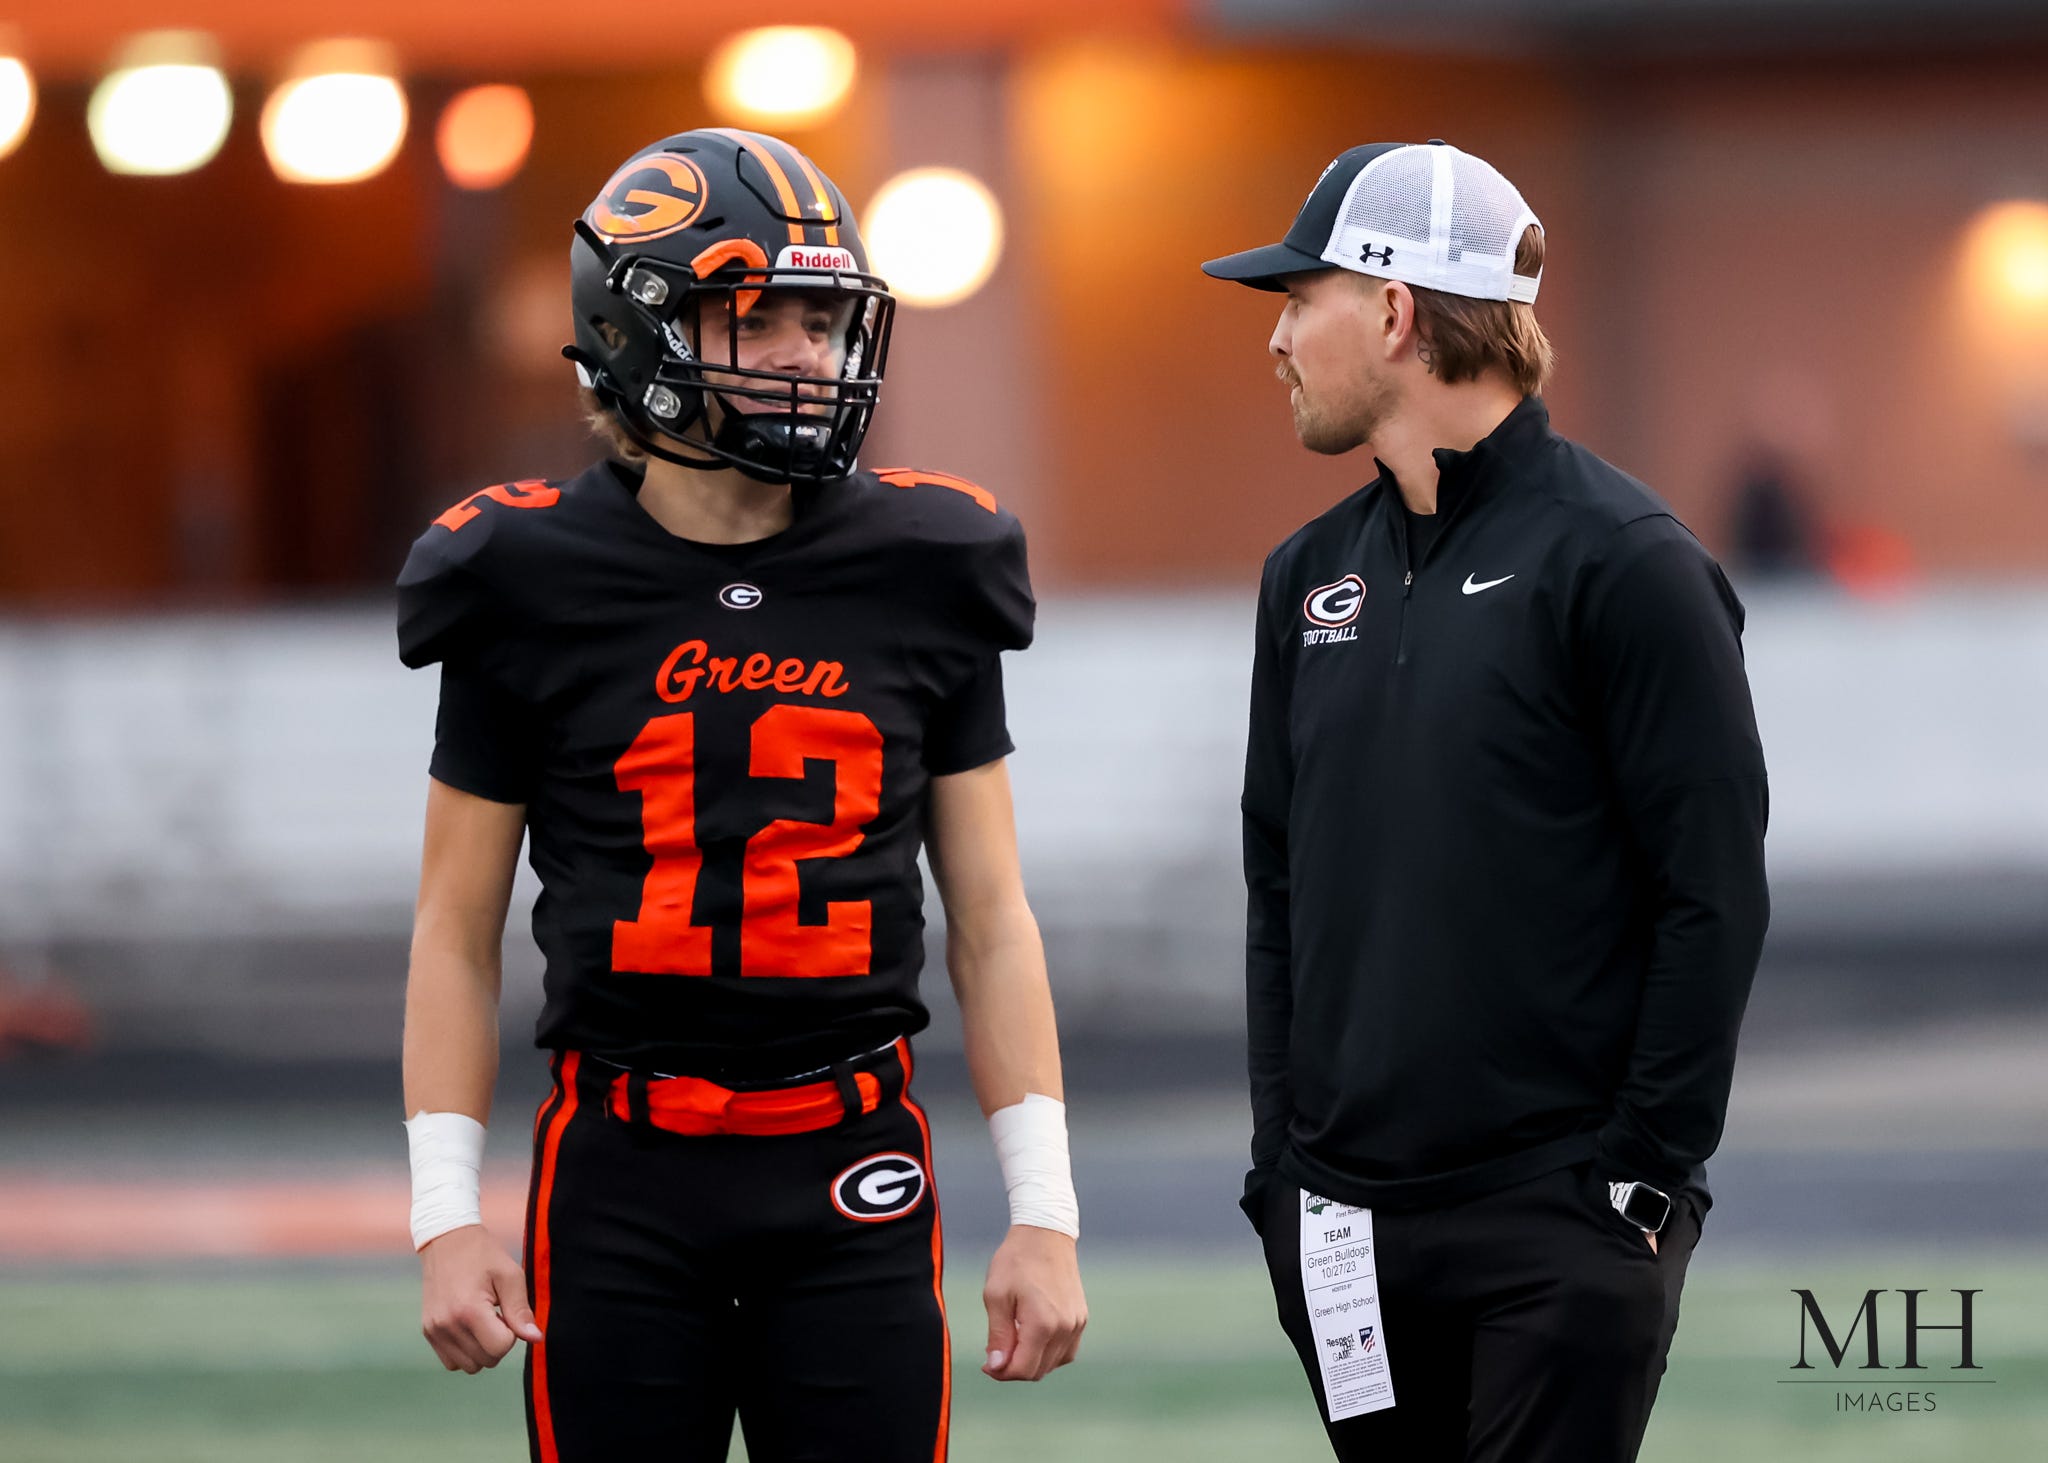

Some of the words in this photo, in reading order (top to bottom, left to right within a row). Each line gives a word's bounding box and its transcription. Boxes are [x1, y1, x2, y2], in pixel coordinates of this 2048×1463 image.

[592, 155, 700, 236] G
[791, 251, 850, 269] Riddell
[720, 583, 762, 609] G
[1310, 581, 1361, 621] G
[1303, 626, 1358, 647] FOOTBALL
[655, 639, 850, 704] Green
[611, 703, 885, 978] 12
[835, 1154, 925, 1218] G
[1323, 1226, 1351, 1243] TEAM
[1307, 1255, 1333, 1269] Green
[1335, 1246, 1370, 1262] Bulldogs
[1322, 1260, 1357, 1279] 10/27/23
[1314, 1308, 1335, 1318] Green
[1335, 1302, 1351, 1313] High
[1352, 1294, 1376, 1308] School
[1326, 1333, 1355, 1348] Respect
